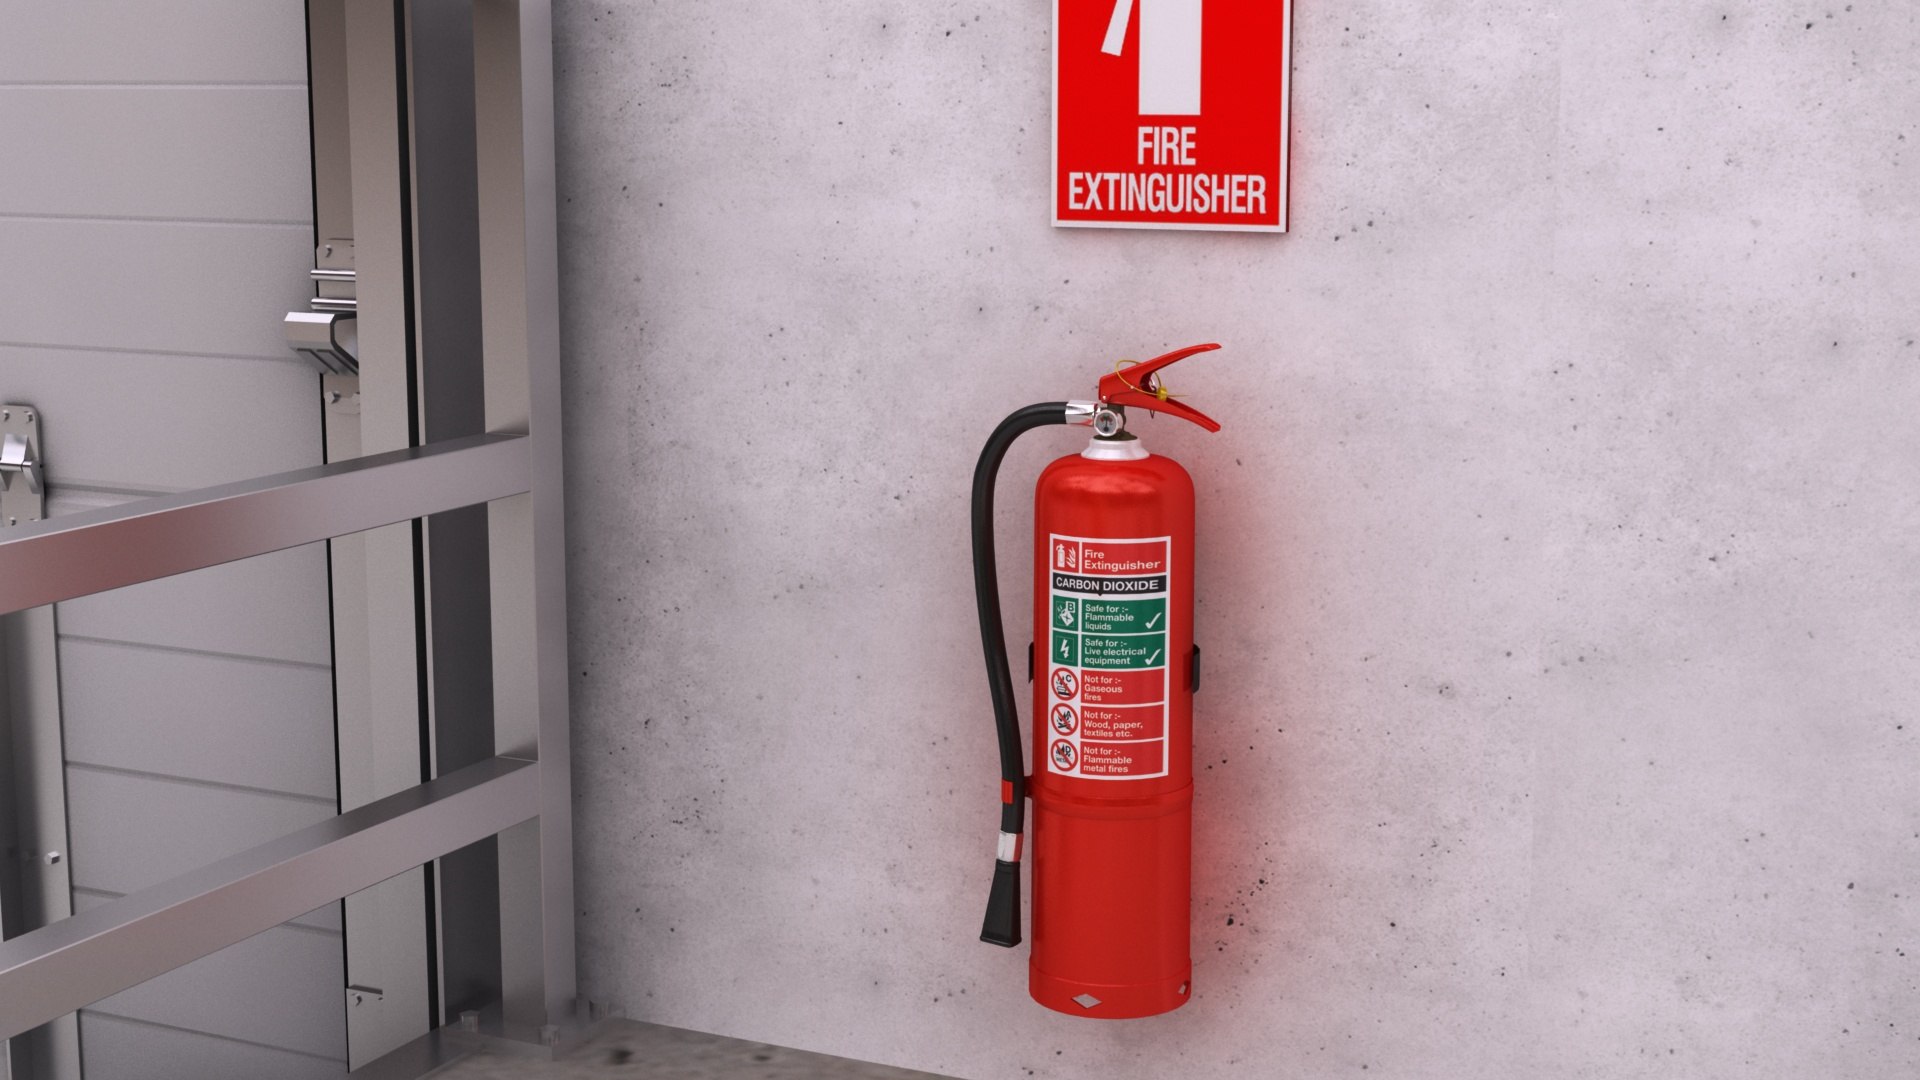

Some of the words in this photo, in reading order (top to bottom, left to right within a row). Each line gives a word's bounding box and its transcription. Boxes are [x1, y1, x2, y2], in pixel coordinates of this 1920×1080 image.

[1137, 126, 1197, 166] FIRE
[1068, 171, 1267, 214] EXTINGUISHER
[1084, 549, 1105, 559] Fire
[1084, 560, 1161, 572] Extinguisher
[1056, 577, 1100, 591] CARBON
[1103, 580, 1159, 591] DIOXIDE
[1085, 604, 1104, 613] Safe
[1106, 604, 1120, 613] for
[1085, 613, 1134, 622] Flammable
[1085, 622, 1112, 631] liquids
[1085, 638, 1103, 647] Safe
[1105, 639, 1118, 647] for
[1084, 647, 1101, 655] Live
[1103, 647, 1147, 656] electrical
[1084, 656, 1131, 666] equipment
[1084, 675, 1099, 683] Not
[1100, 675, 1113, 684] for
[1084, 684, 1123, 693] Gaseous
[1084, 693, 1102, 701] fires
[1084, 711, 1098, 719] Not
[1100, 711, 1113, 720] for
[1084, 720, 1111, 729] Wood,
[1113, 722, 1143, 730] paper,
[1084, 729, 1113, 737] textiles
[1084, 746, 1098, 755] Not
[1100, 747, 1112, 755] for
[1084, 755, 1132, 764] Flammable
[1083, 765, 1106, 773] metal
[1108, 765, 1129, 773] fires
